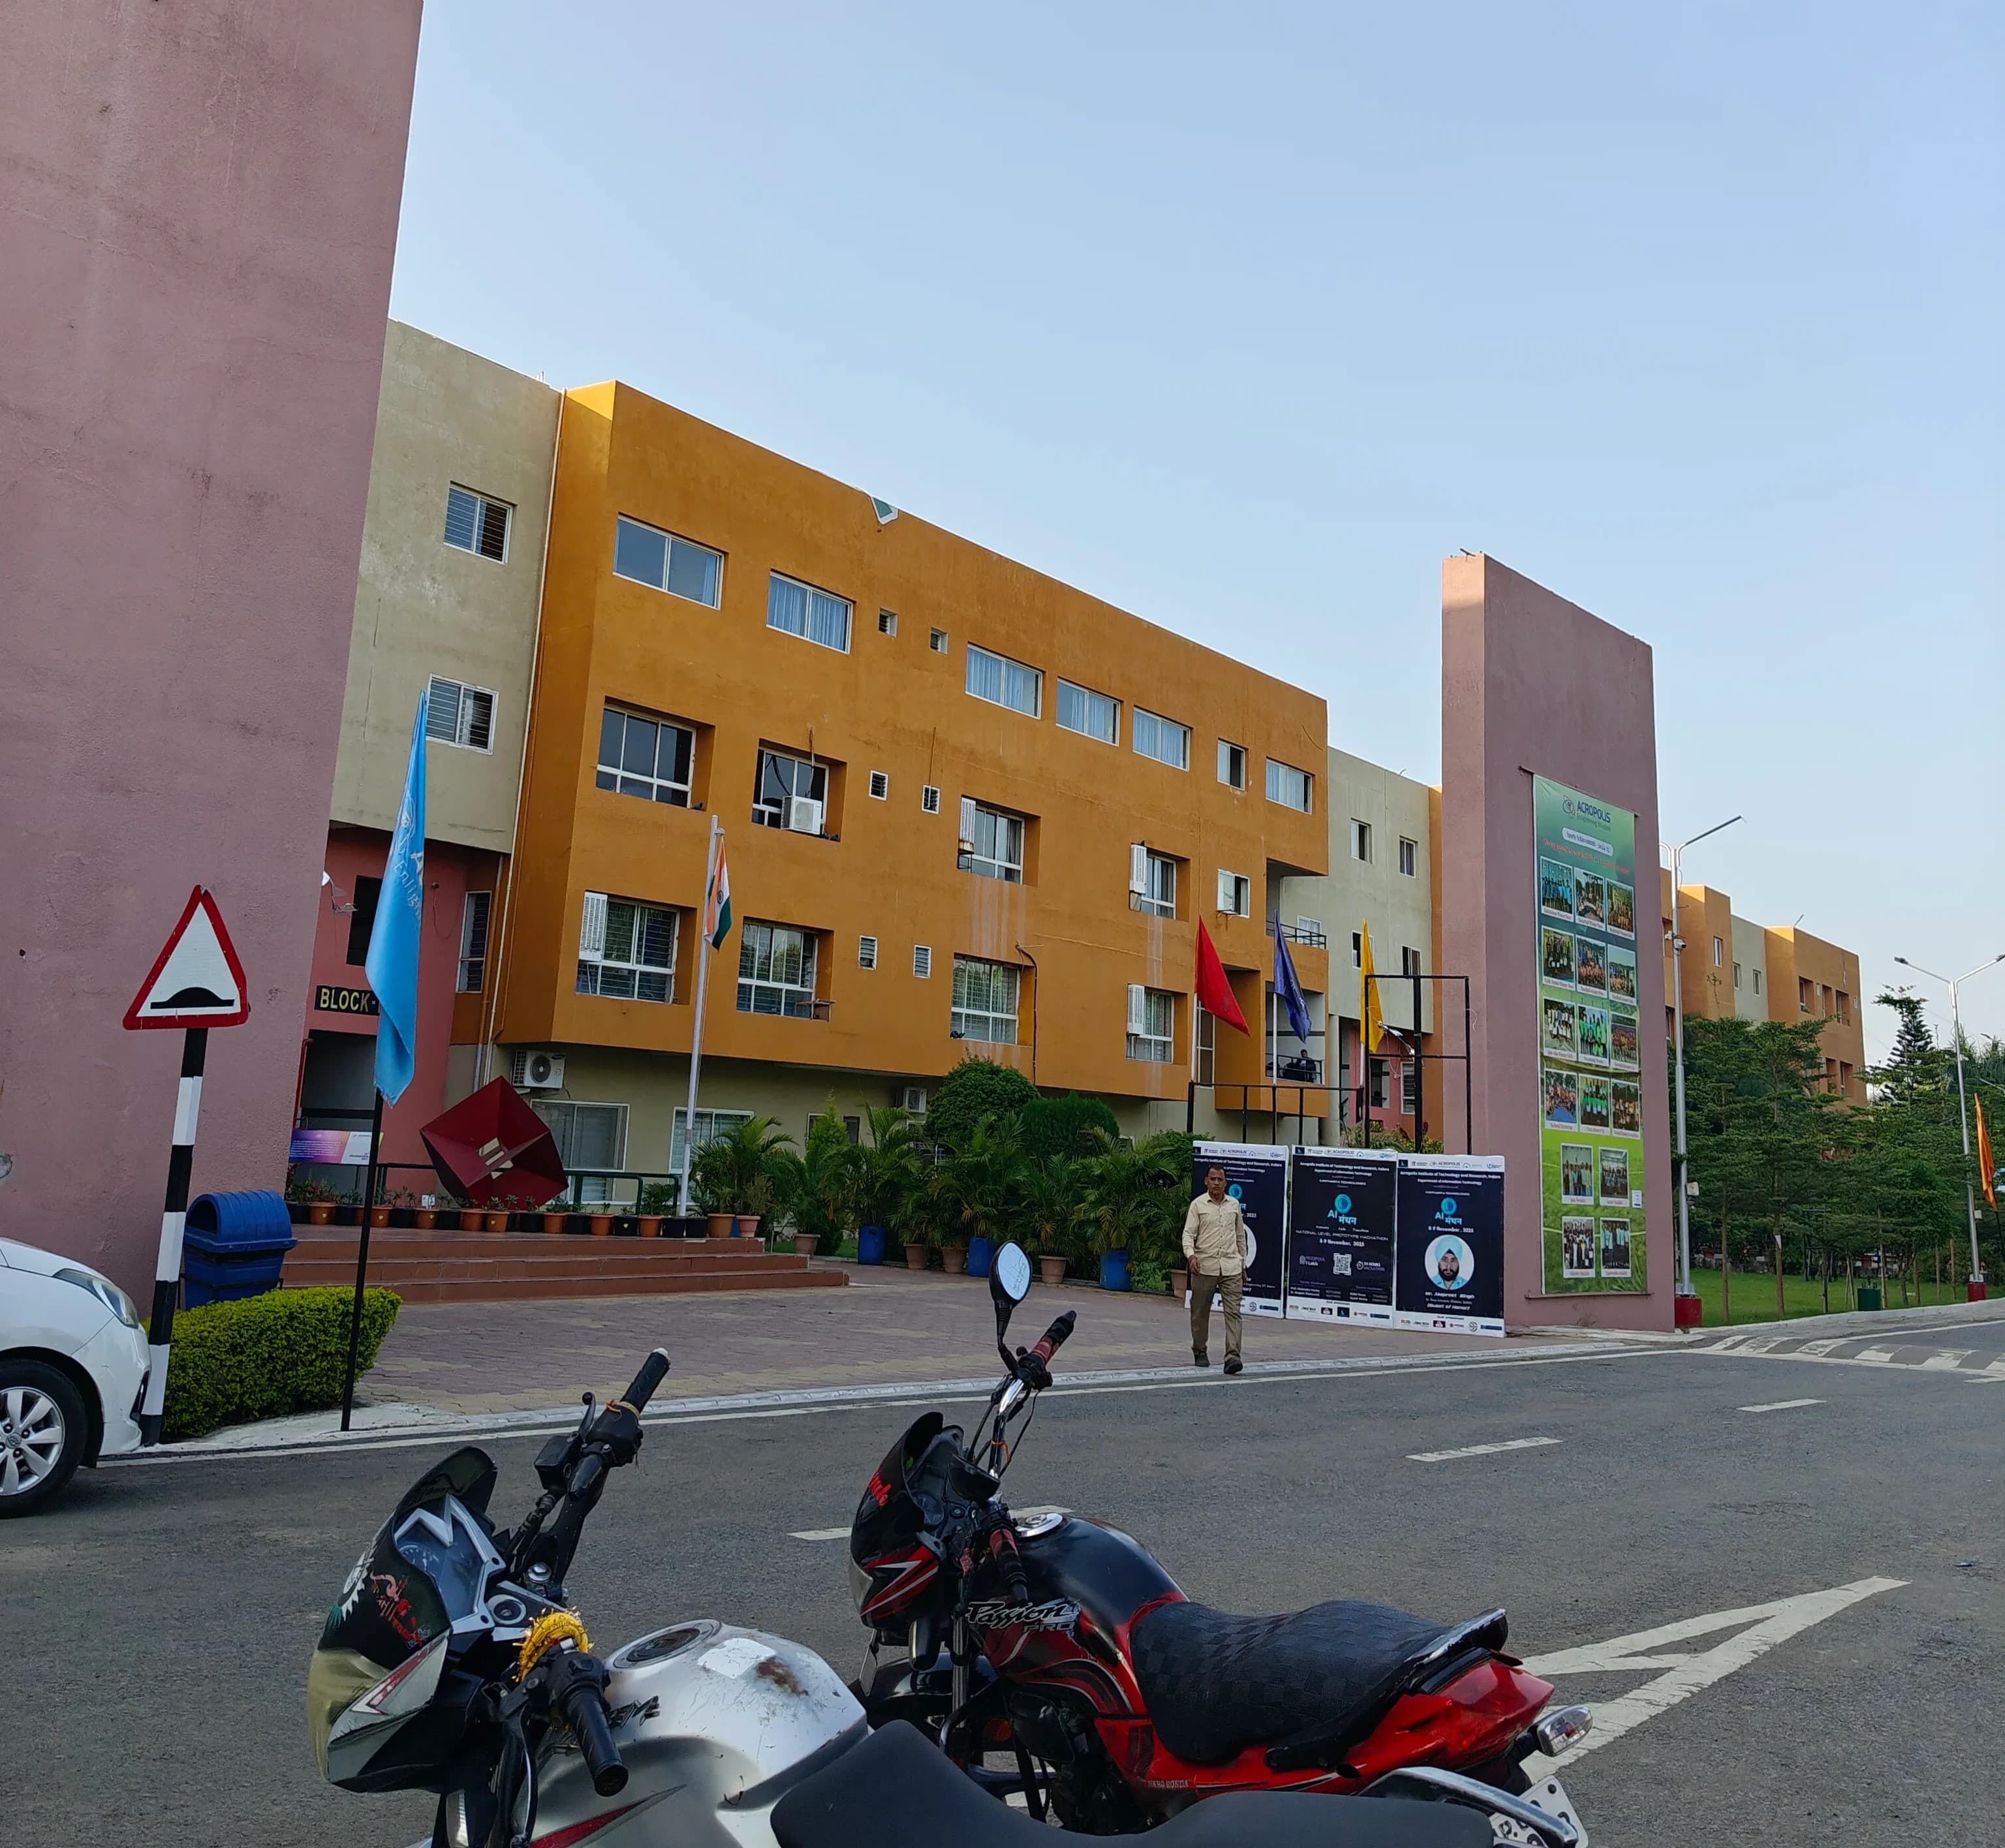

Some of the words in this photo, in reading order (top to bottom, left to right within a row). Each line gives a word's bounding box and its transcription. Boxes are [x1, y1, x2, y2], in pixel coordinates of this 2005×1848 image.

[1577, 801, 1611, 823] ACROPOLIS
[1328, 1209, 1337, 1218] AI
[1339, 1214, 1358, 1225] मंथन
[1445, 1215, 1463, 1225] मंथन
[965, 1601, 1080, 1629] Passion
[1023, 1621, 1075, 1632] PRO
